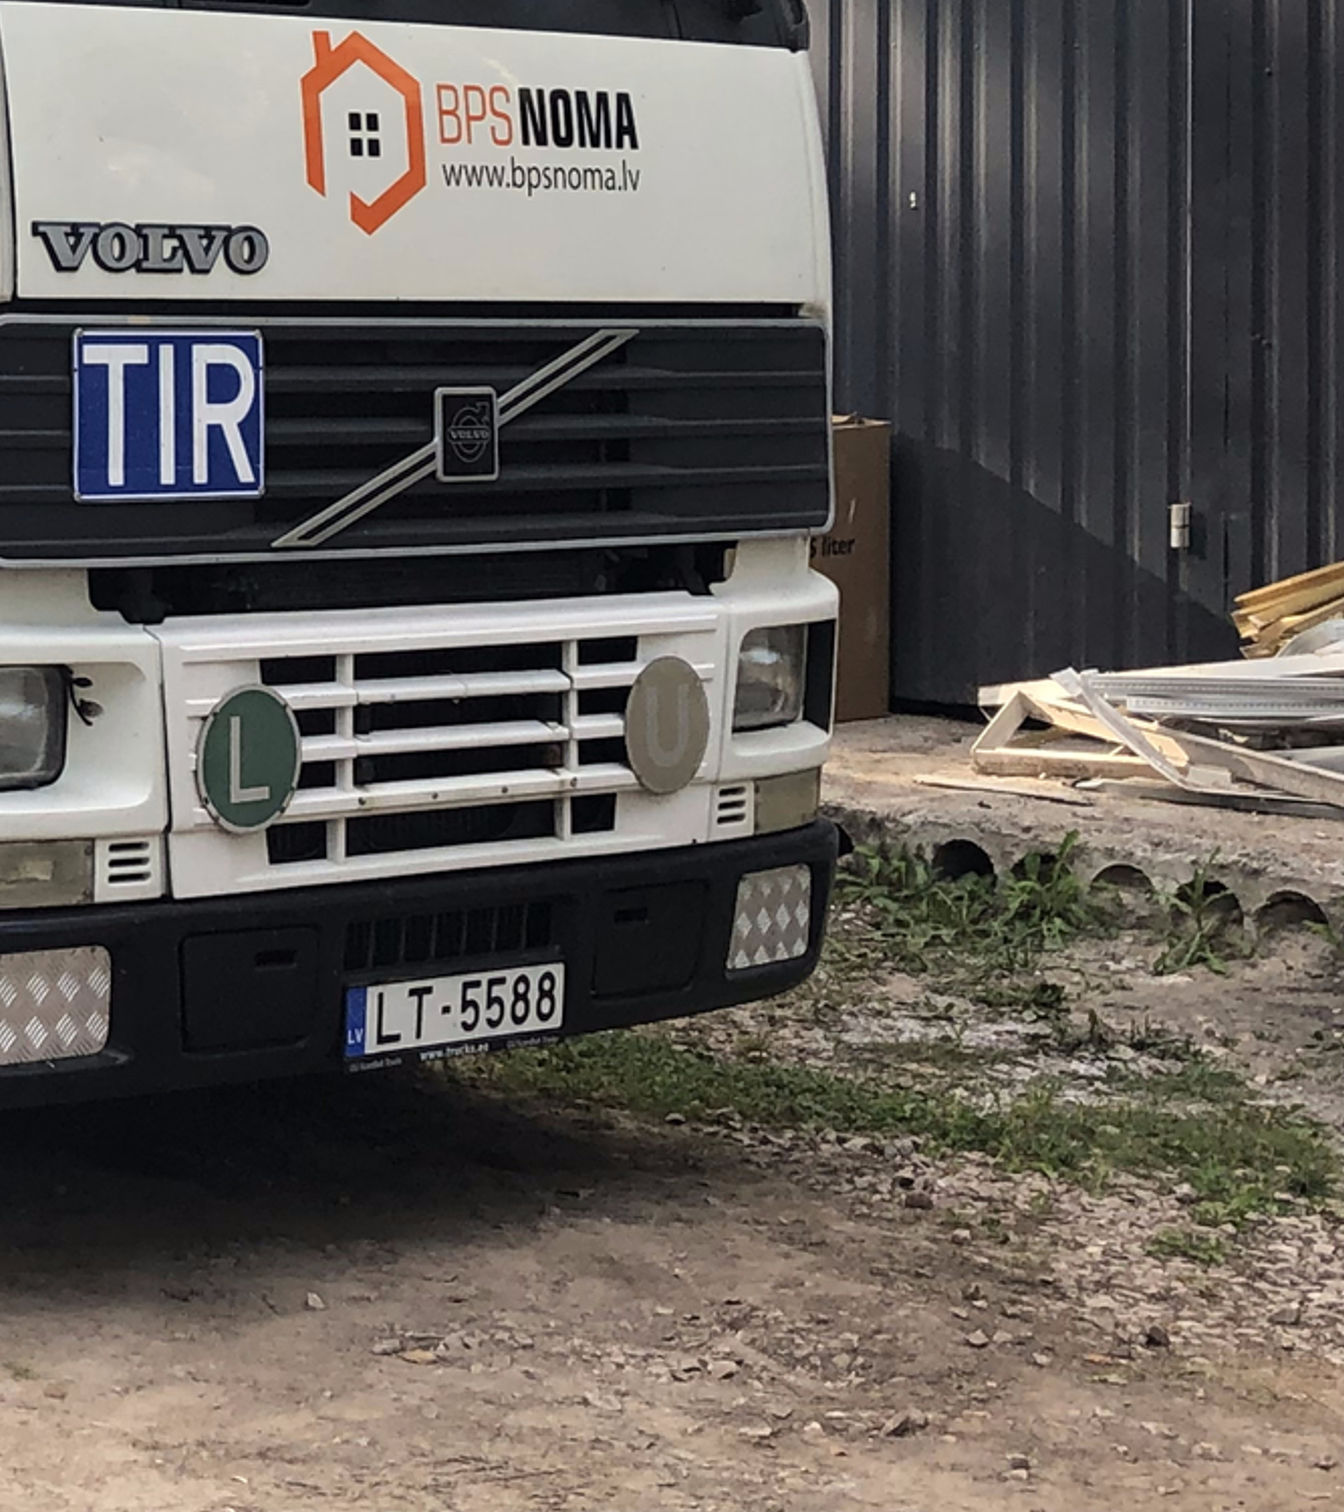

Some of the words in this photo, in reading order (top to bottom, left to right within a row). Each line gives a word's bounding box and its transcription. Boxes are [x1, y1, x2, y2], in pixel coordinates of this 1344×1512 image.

[442, 156, 641, 197] www.bpsnoma.lv
[32, 221, 269, 275] VOLVO
[82, 343, 255, 487] TIR
[450, 430, 490, 441] VOLVO
[822, 535, 855, 558] liter
[229, 716, 270, 804] L
[376, 971, 556, 1045] LT-5588
[347, 1028, 363, 1045] LV
